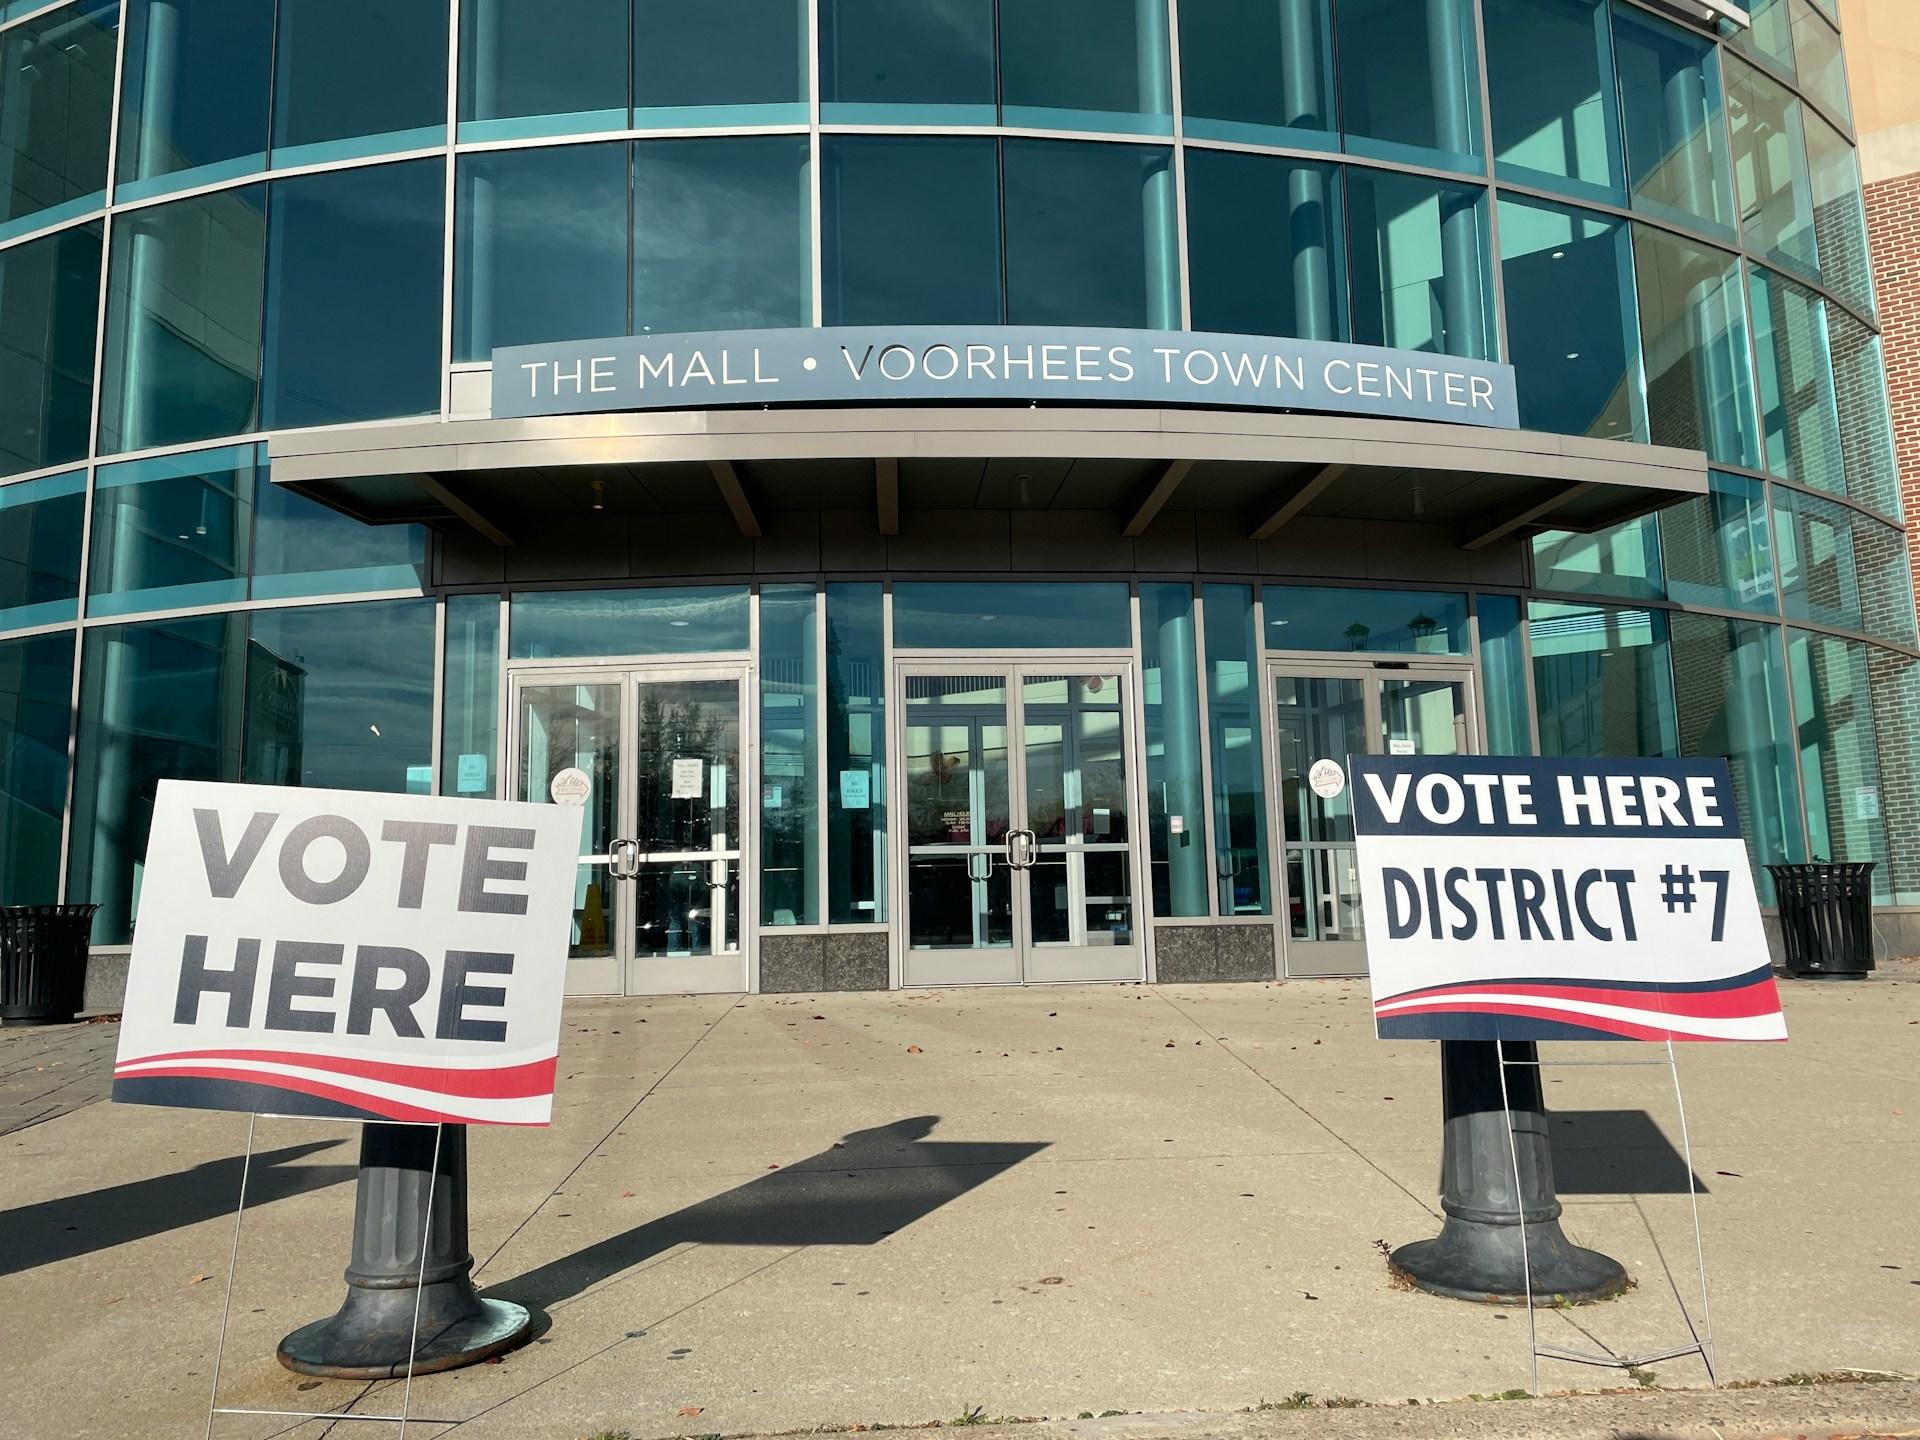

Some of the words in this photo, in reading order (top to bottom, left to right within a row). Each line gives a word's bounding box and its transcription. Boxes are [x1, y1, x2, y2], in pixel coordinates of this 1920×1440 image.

[521, 356, 617, 398] THE
[639, 348, 780, 389] MALL
[840, 344, 1135, 382] VOORHEES
[1153, 348, 1304, 390] TOWN
[1323, 358, 1495, 410] CENTER
[1364, 773, 1538, 825] VOTE
[1557, 775, 1724, 827] HERE
[192, 808, 536, 916] VOTE
[1381, 866, 1638, 942] DISTRICT
[1660, 864, 1730, 942] #7
[172, 934, 515, 1043] HERE
